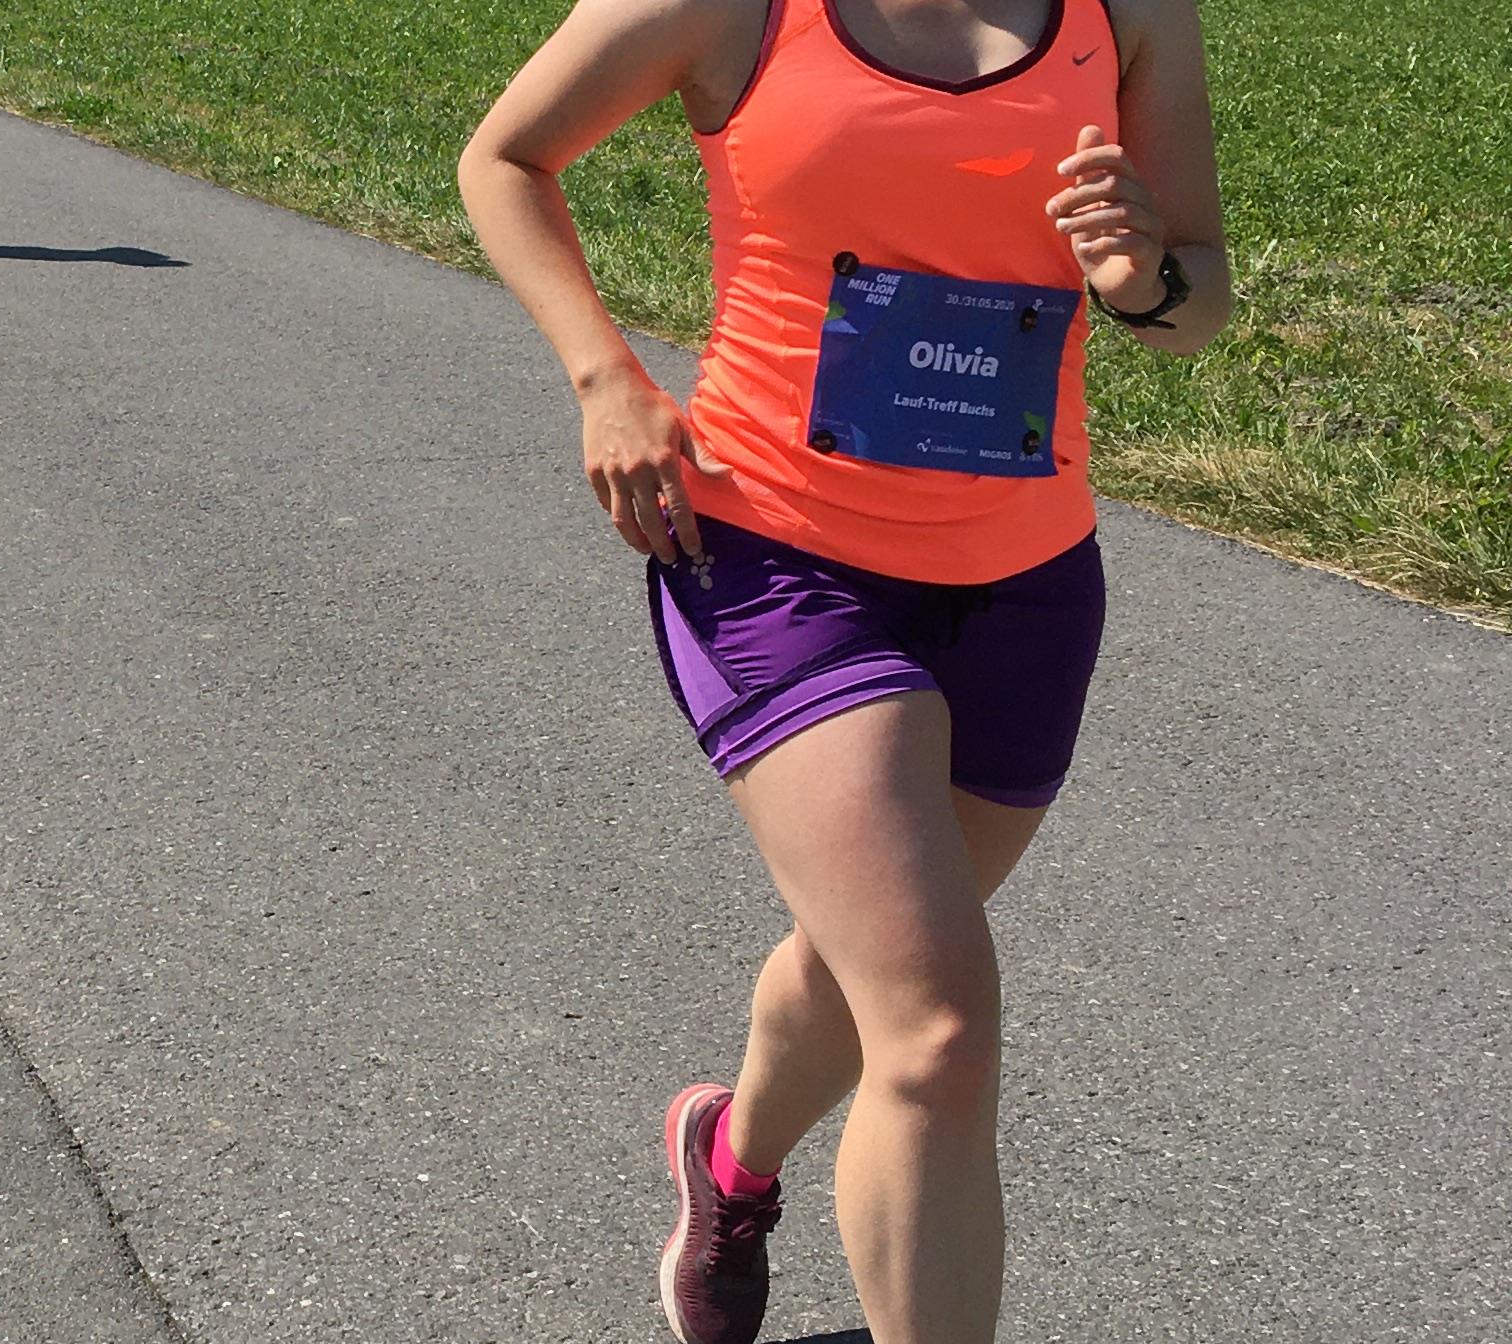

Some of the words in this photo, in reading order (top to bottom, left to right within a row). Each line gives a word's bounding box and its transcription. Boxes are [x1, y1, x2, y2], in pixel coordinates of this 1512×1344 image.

[847, 278, 897, 296] MILLION
[876, 272, 902, 286] ONE
[865, 293, 892, 307] RUN
[909, 340, 1000, 378] Olivia
[894, 393, 958, 414] Lauf-Treff
[959, 401, 996, 417] Buchs
[978, 448, 1013, 461] MIGROS
